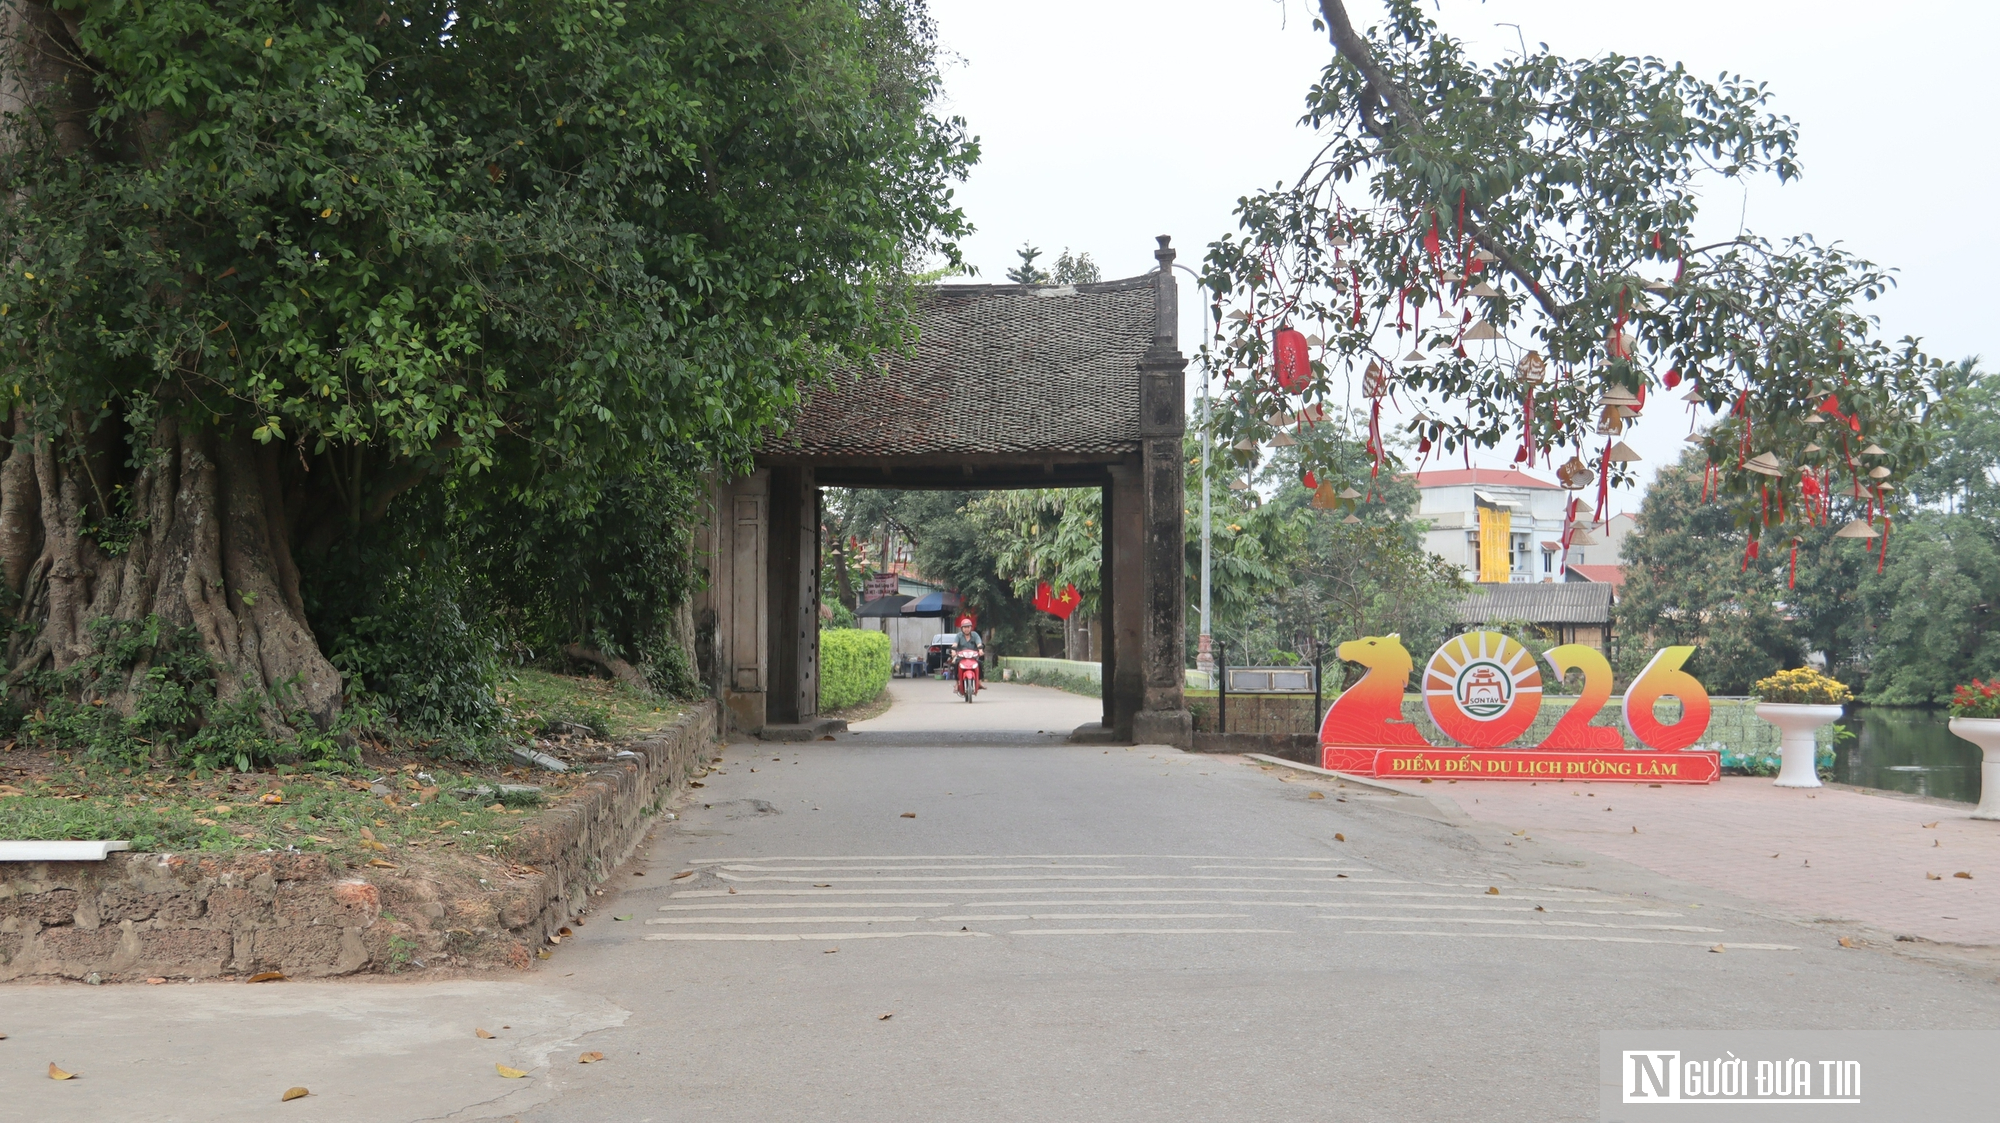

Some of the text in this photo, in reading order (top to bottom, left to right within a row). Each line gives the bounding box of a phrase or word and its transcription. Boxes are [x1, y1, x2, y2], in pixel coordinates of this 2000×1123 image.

[1392, 753, 1677, 776] ĐIỂM ĐẾN DU LỊCH ĐƯỜNG LÂM
